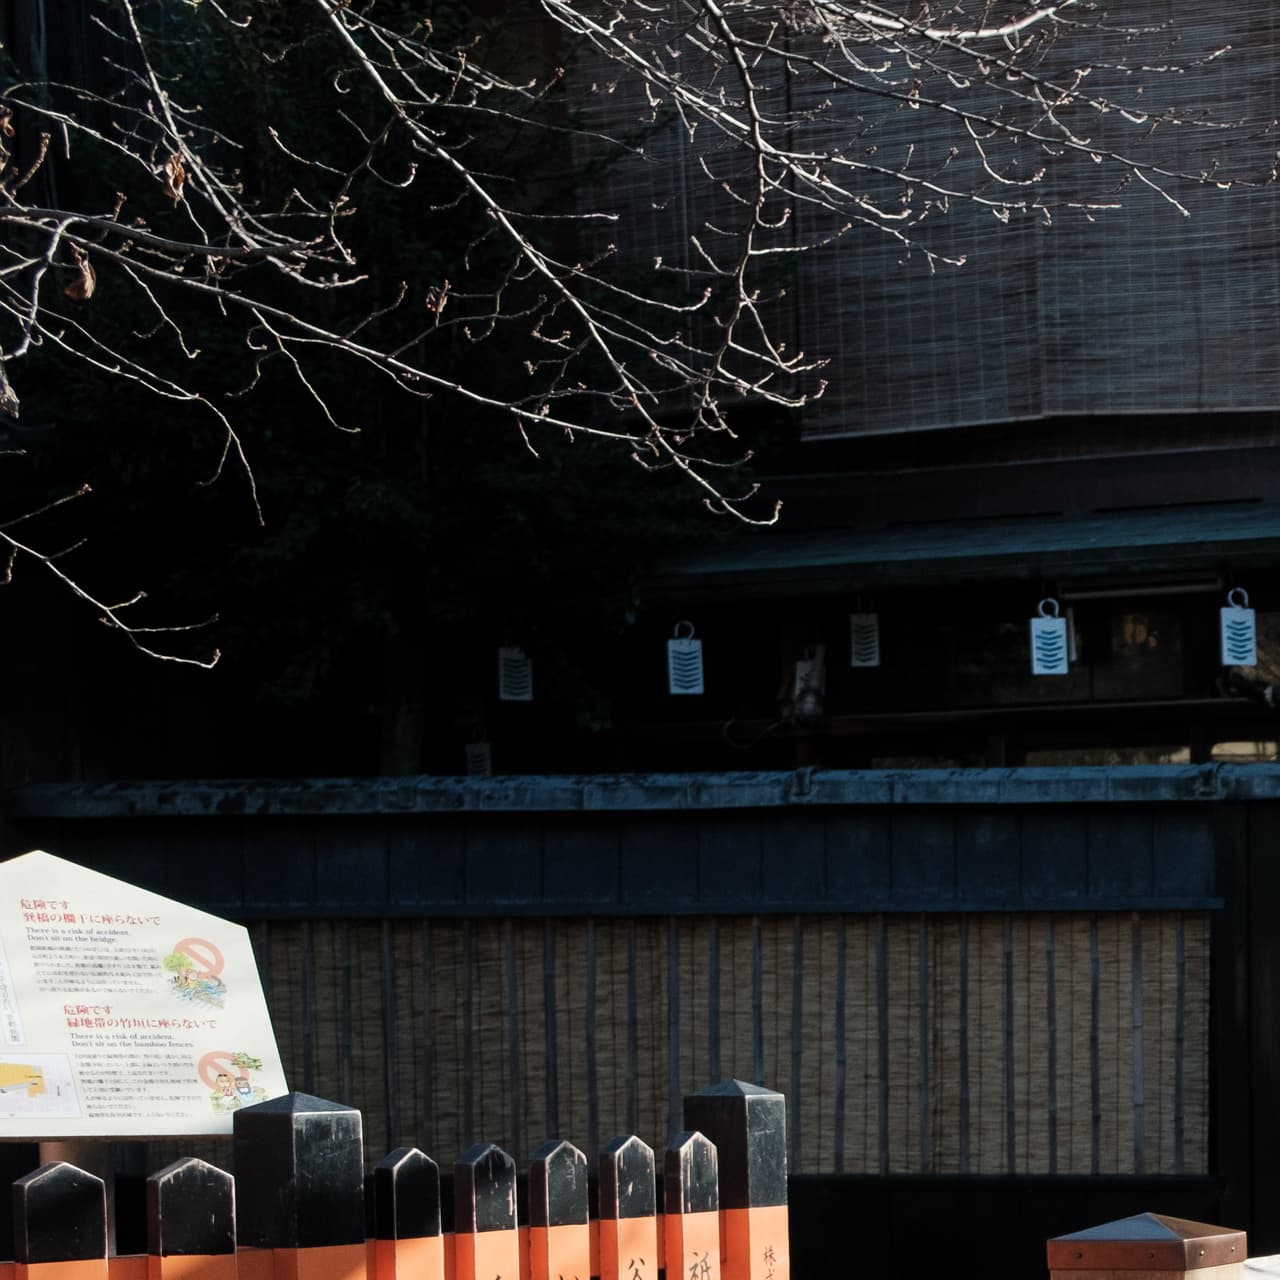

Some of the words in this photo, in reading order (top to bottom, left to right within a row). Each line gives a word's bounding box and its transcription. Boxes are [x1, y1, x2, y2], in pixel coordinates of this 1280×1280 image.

[20, 899, 69, 911] 危険です
[64, 1005, 112, 1015] 危険です
